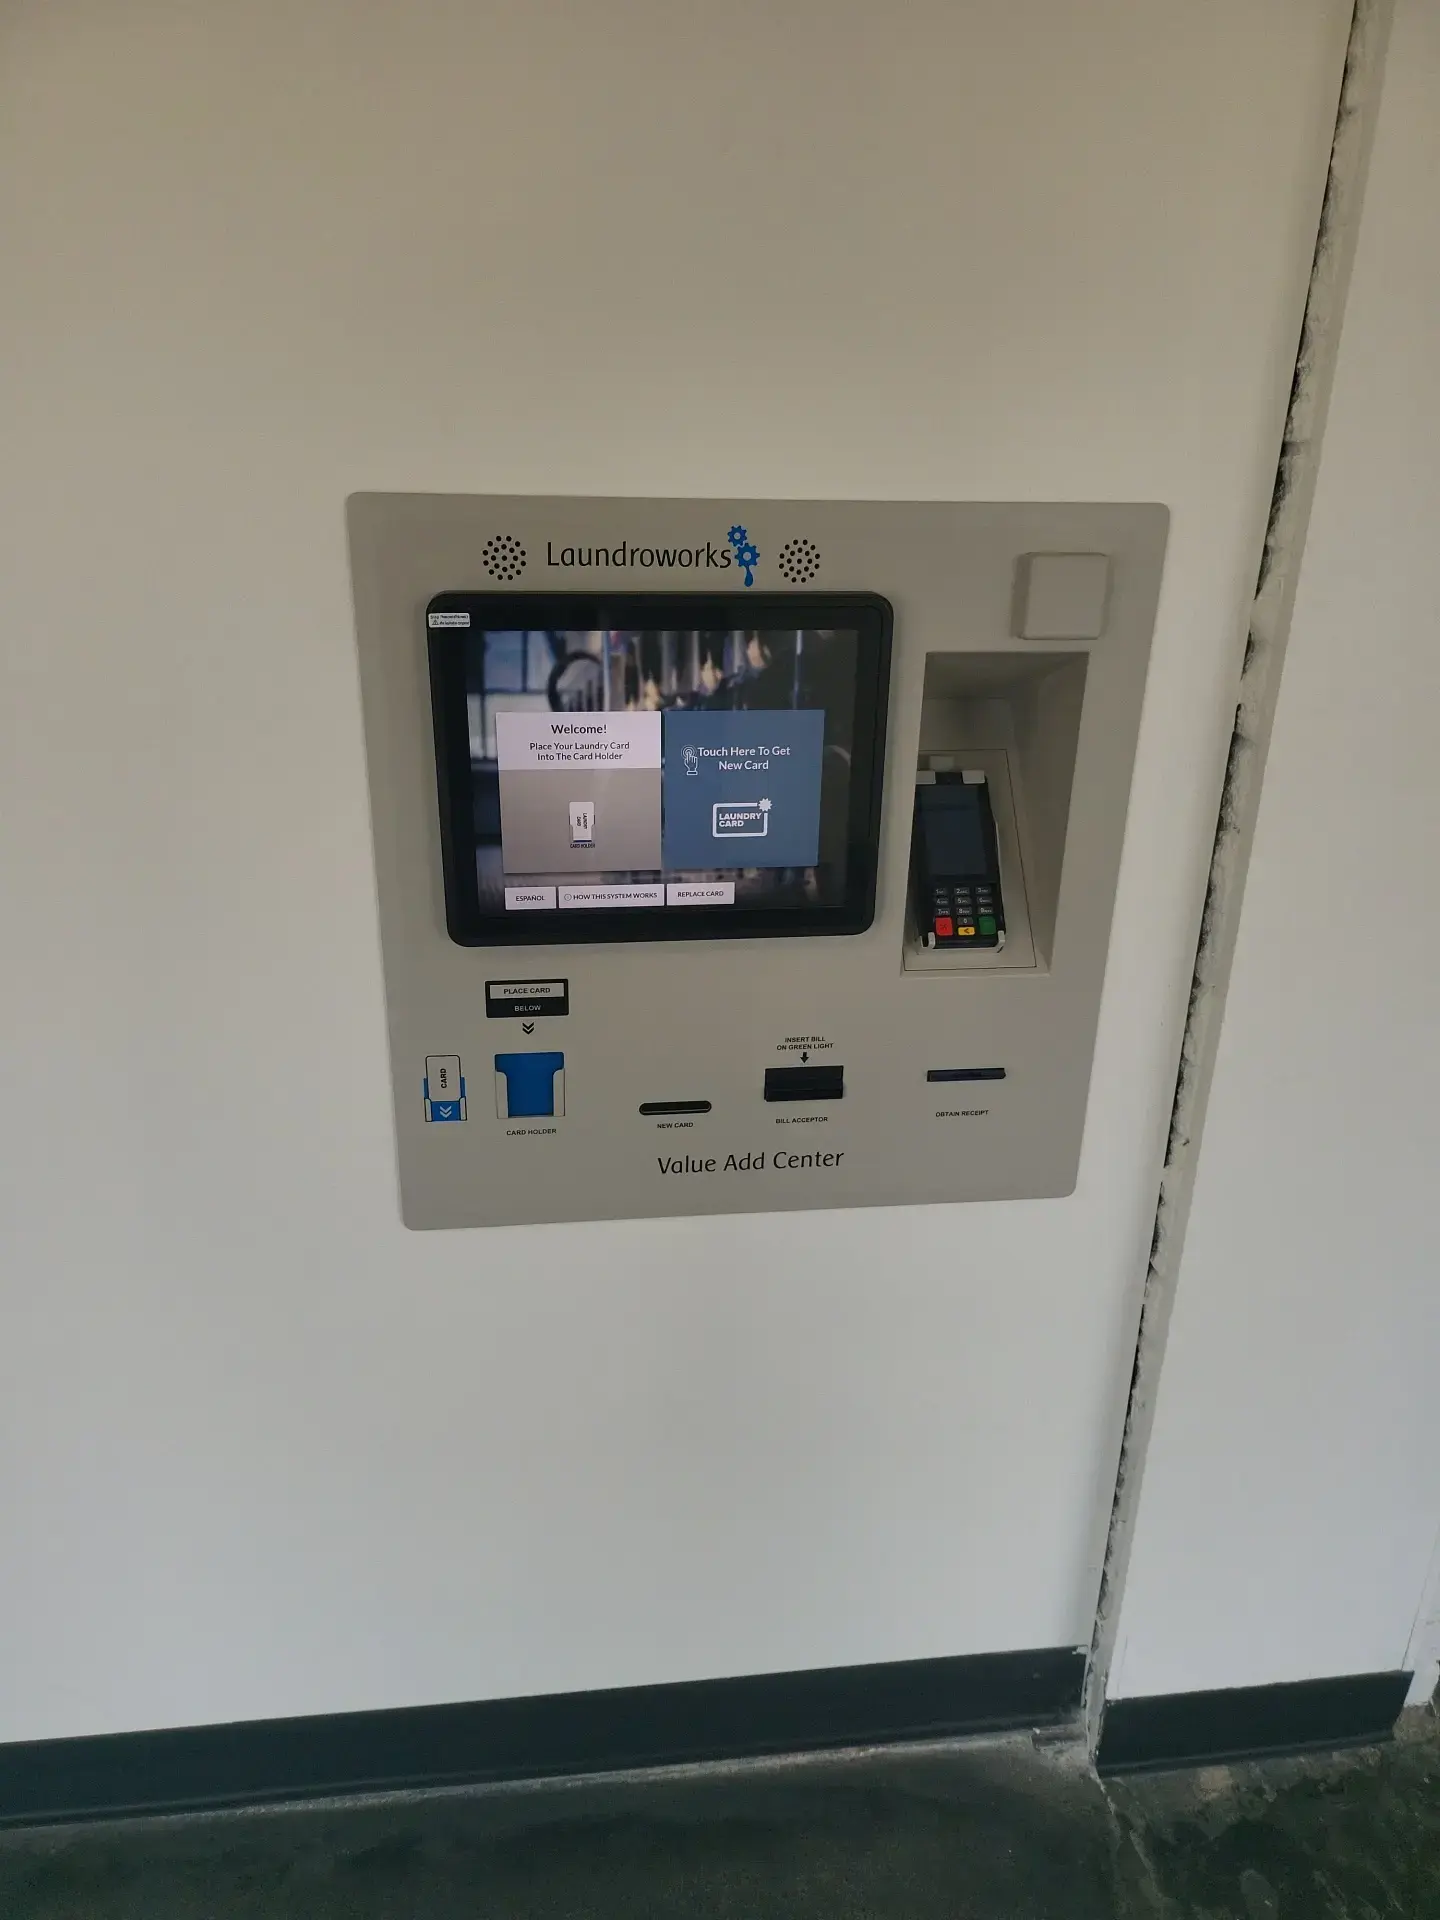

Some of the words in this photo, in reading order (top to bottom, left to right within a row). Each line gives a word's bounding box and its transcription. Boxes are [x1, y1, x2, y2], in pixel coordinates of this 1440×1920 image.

[546, 540, 733, 569] Laundroworks
[551, 724, 608, 735] Welcome!
[529, 742, 552, 751] Place
[554, 742, 573, 750] Your
[575, 742, 608, 752] Laundry
[610, 742, 630, 750] Card
[697, 746, 728, 757] Touch
[730, 746, 756, 756] Here
[758, 746, 770, 756] To
[772, 746, 791, 756] Get
[537, 753, 554, 761] Into
[556, 753, 572, 761] The
[595, 752, 623, 760] Holder
[719, 761, 742, 770] New
[744, 760, 769, 770] Card
[719, 812, 762, 820] LAUNDRY
[573, 893, 591, 901] HOW
[514, 1004, 541, 1012] BELOW
[440, 1068, 448, 1089] CARD
[961, 1109, 989, 1117] RECEIPT
[657, 1155, 717, 1175] Value
[723, 1152, 765, 1171] Add
[773, 1150, 845, 1169] Center
